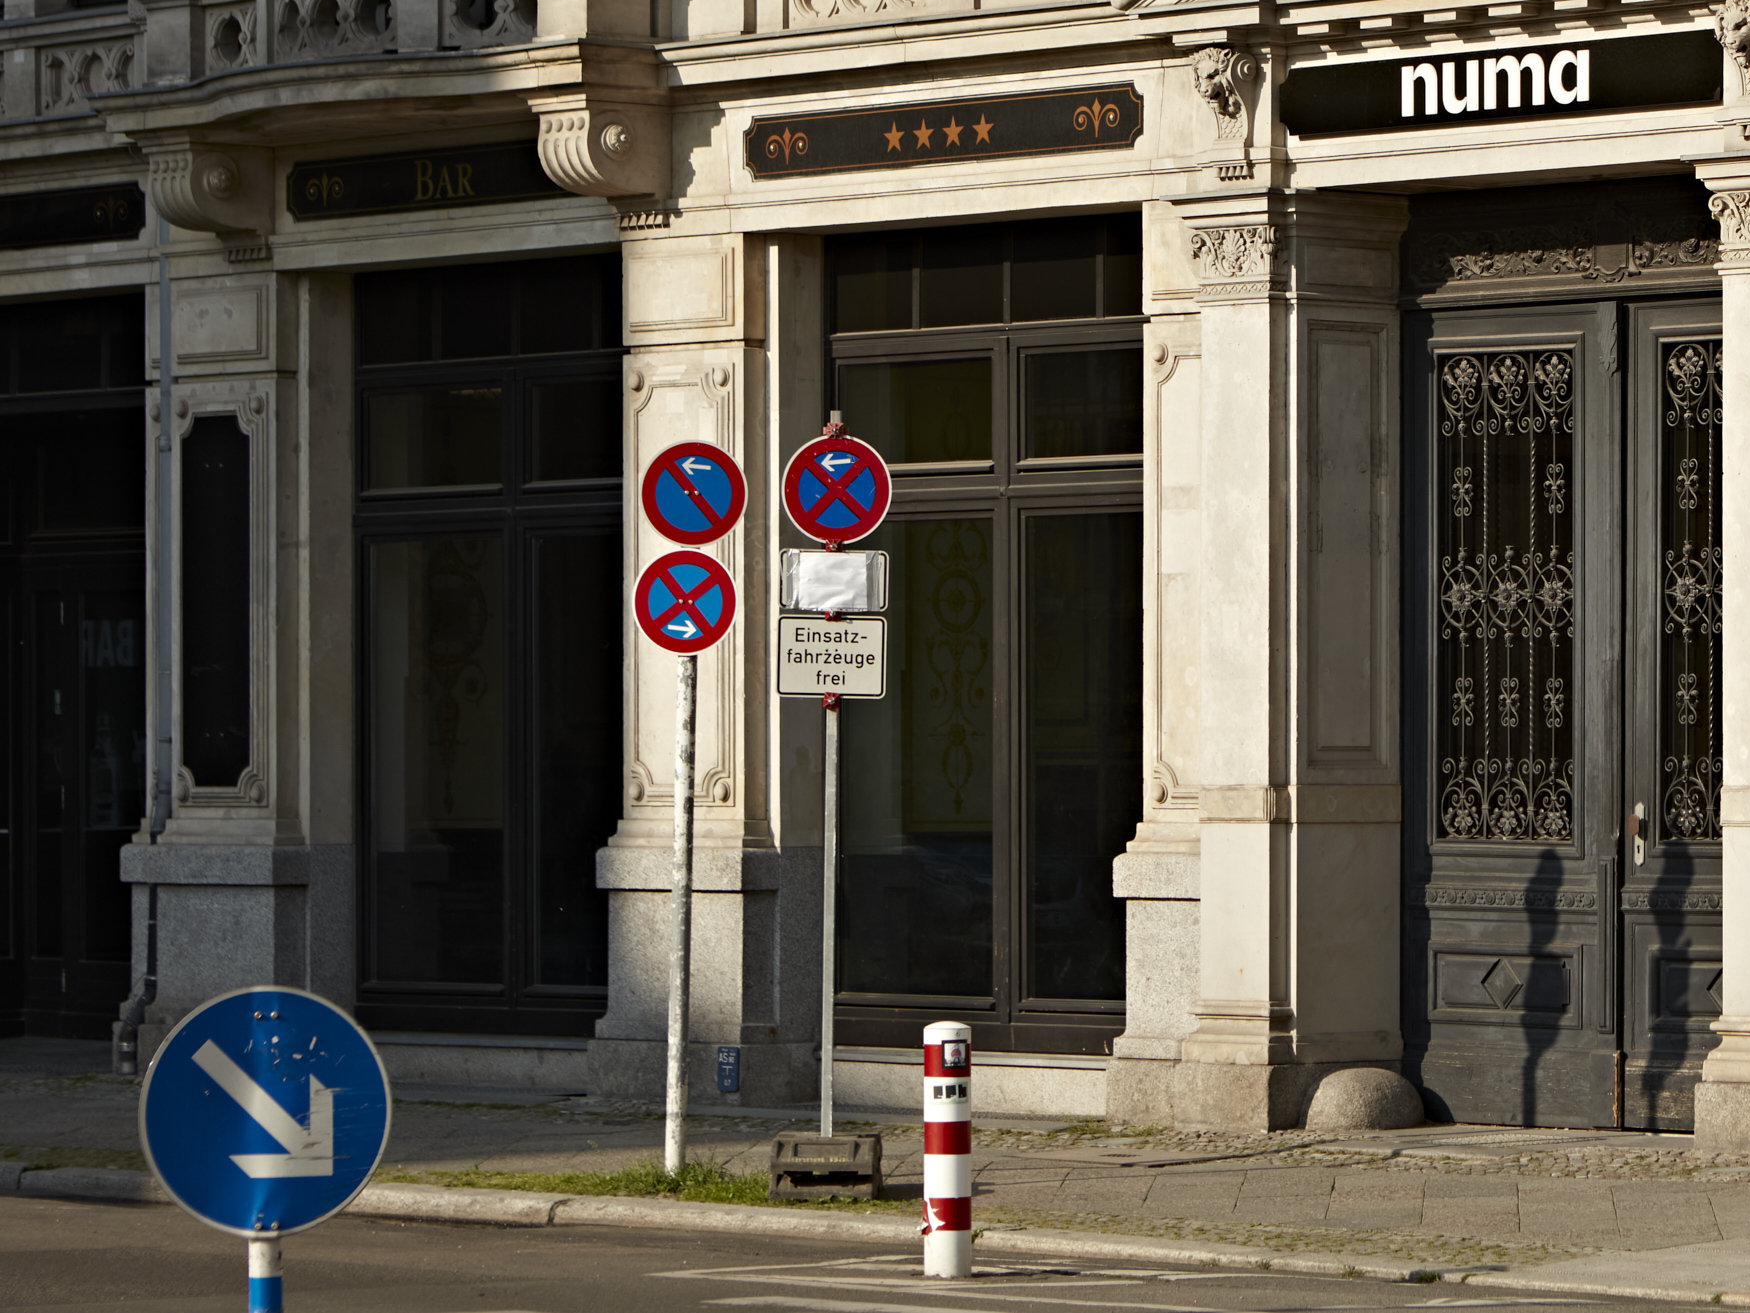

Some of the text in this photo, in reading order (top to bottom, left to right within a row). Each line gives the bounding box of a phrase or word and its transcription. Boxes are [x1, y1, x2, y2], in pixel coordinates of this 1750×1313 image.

[1401, 49, 1590, 118] numa
[413, 159, 476, 201] BAR
[795, 627, 868, 644] Einsatz-
[787, 648, 876, 669] fahrzeuge
[816, 670, 846, 686] frei
